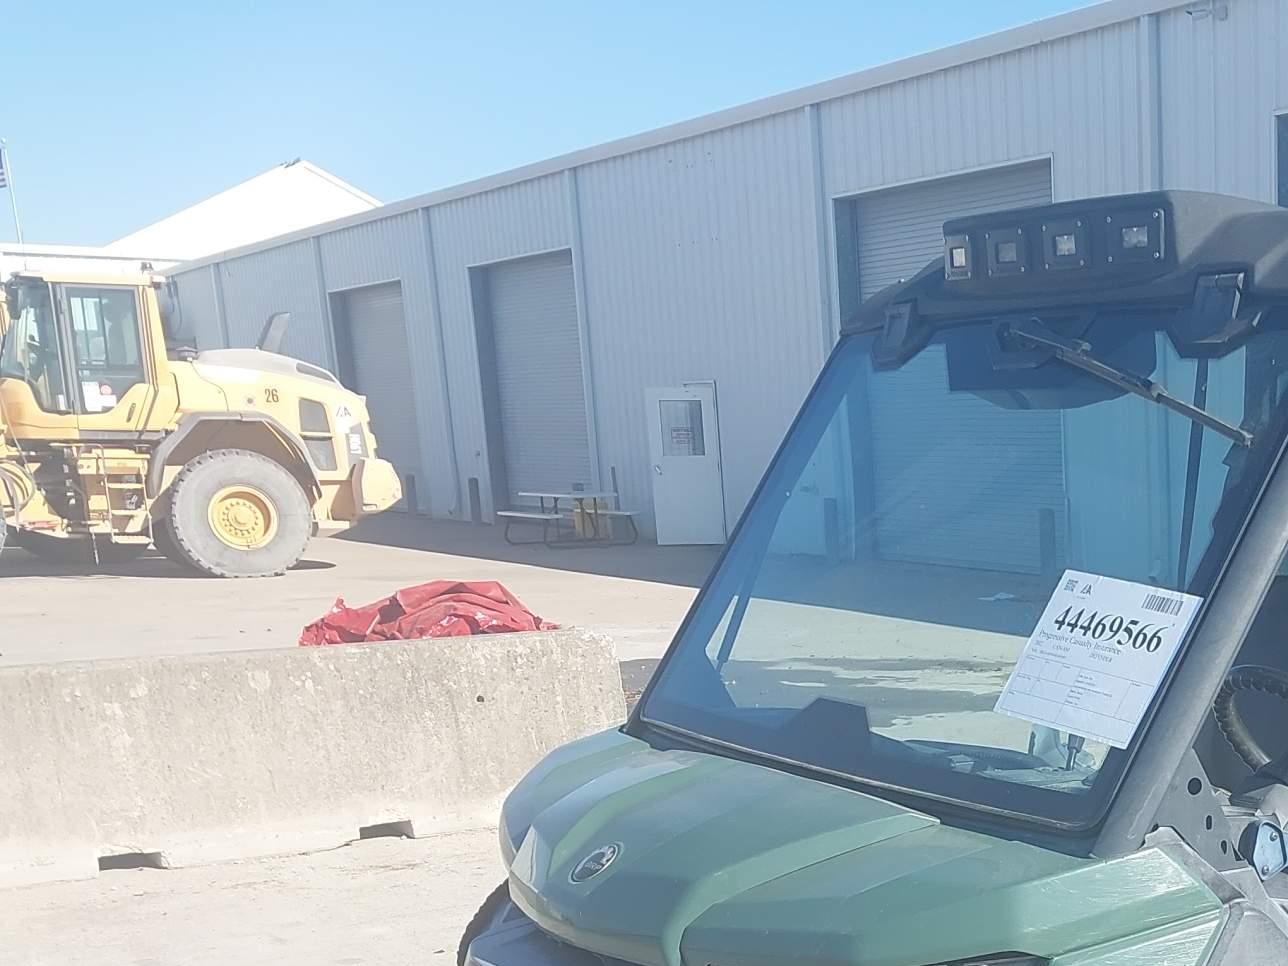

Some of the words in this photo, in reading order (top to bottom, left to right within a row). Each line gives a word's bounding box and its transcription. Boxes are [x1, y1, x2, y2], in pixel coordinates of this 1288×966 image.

[264, 388, 280, 403] 26
[1053, 605, 1169, 653] 44469566
[1069, 636, 1093, 650] Casualty
[1093, 641, 1122, 656] Insurance
